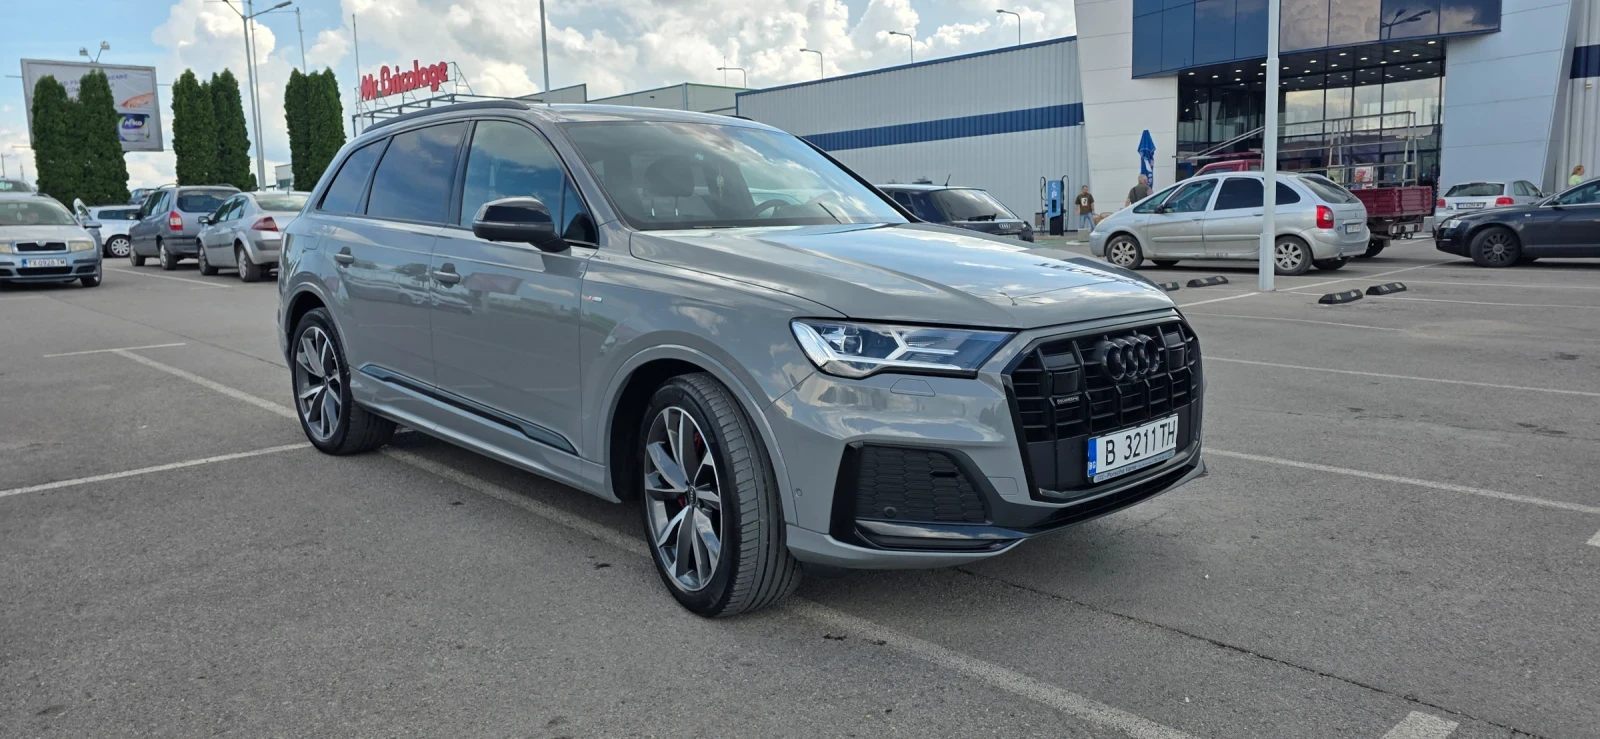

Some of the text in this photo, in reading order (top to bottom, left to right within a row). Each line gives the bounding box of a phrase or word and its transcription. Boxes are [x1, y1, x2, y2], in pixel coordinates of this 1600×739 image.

[361, 60, 448, 101] Mr Bricolage
[1105, 420, 1176, 466] B 3211 TH
[1089, 460, 1096, 470] BG
